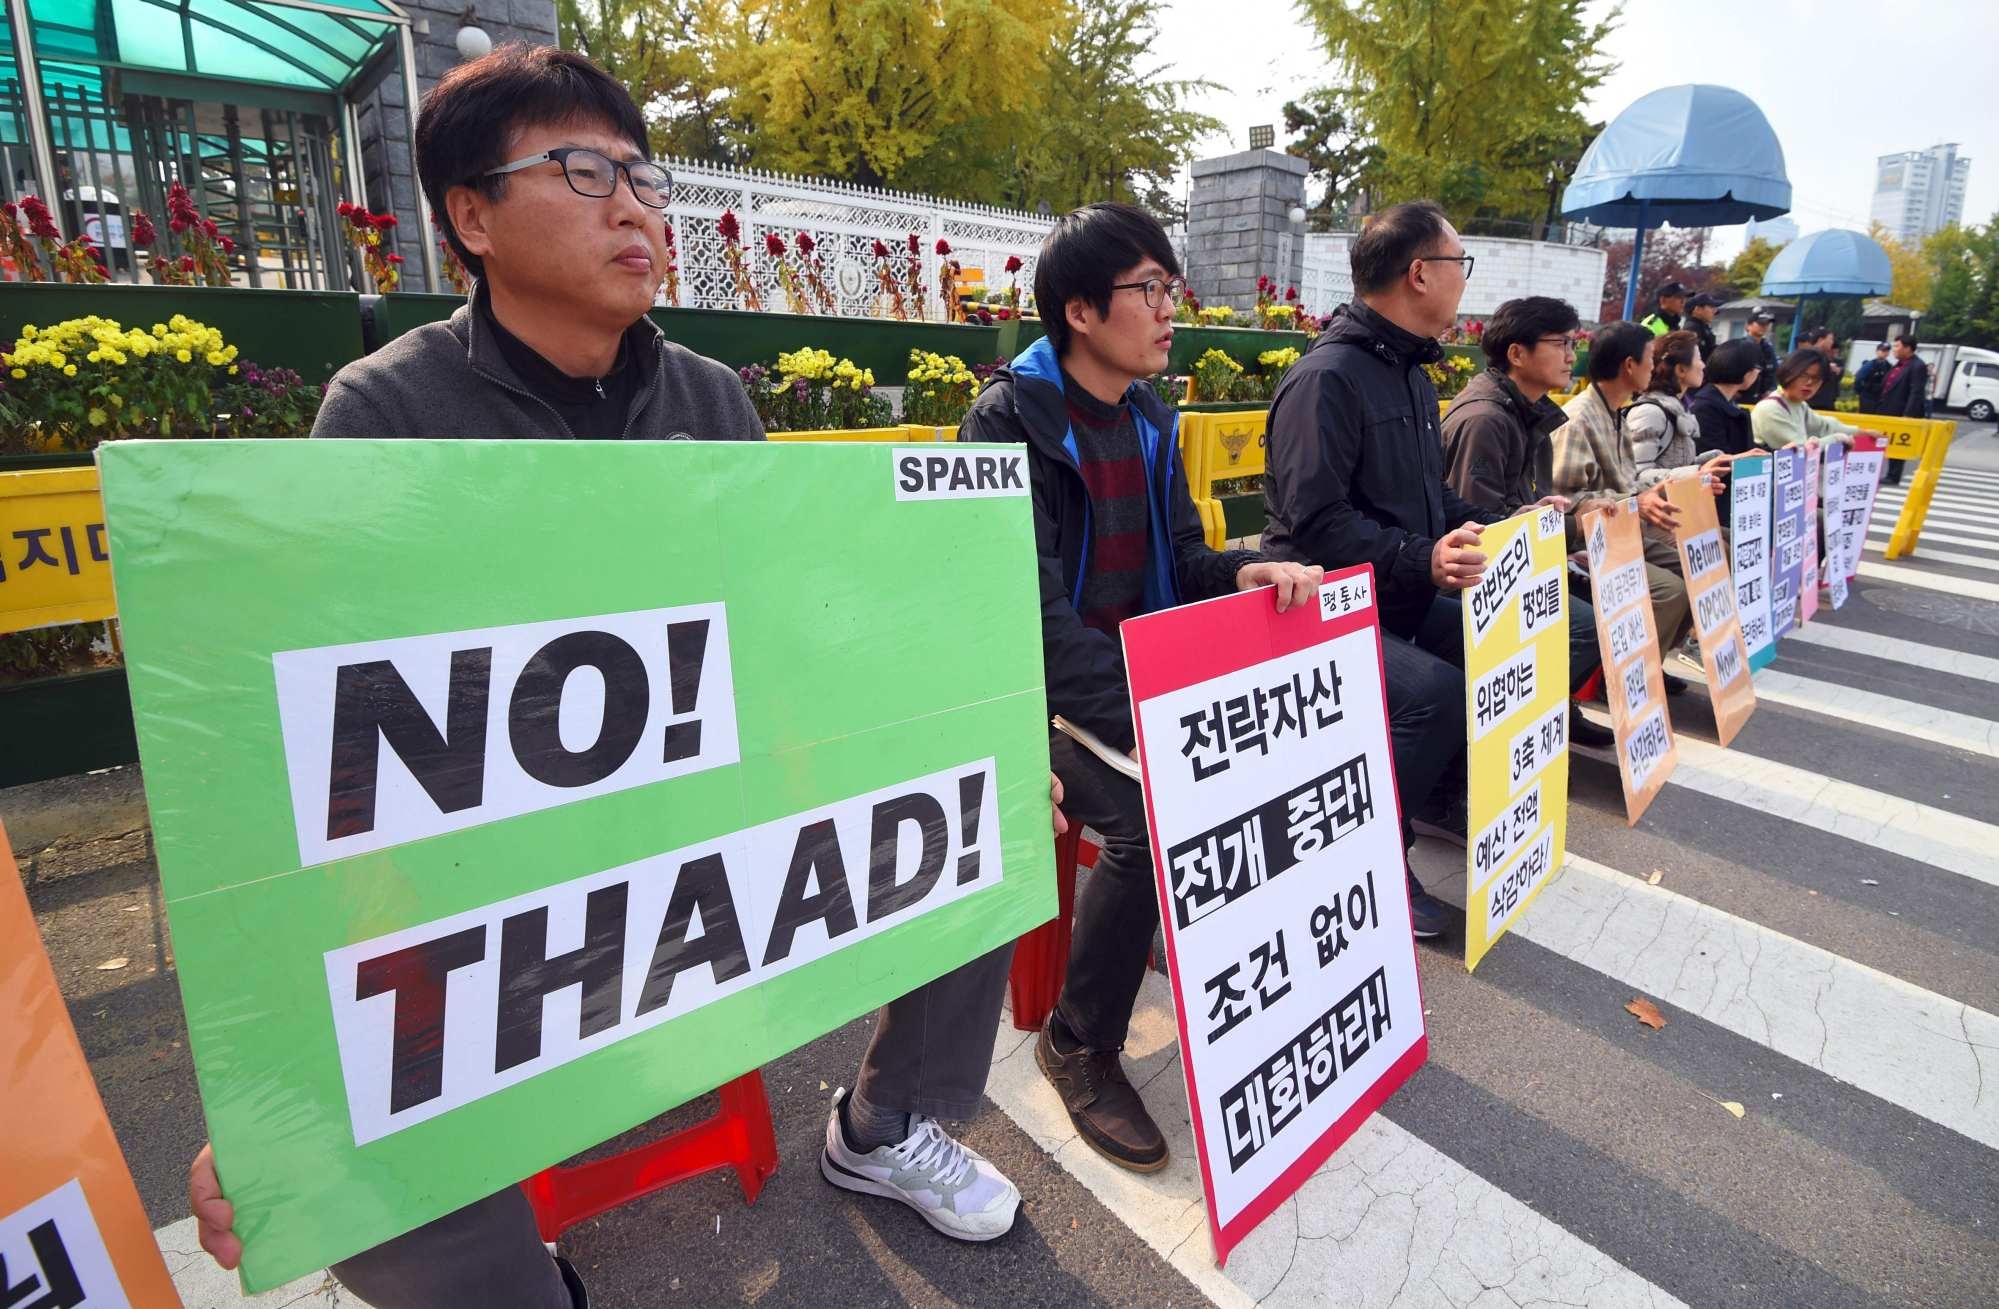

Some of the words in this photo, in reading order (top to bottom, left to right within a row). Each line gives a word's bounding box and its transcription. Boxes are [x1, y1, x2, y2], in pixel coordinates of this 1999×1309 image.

[900, 456, 1024, 493] SPARK
[1472, 532, 1530, 633] 한반도의
[1686, 541, 1722, 576] Return
[1323, 586, 1367, 611] 평통사
[1523, 577, 1560, 629] 평화를
[1698, 589, 1732, 631] OPCON
[1612, 622, 1628, 657] 도입
[1716, 639, 1739, 683] Now!
[1179, 660, 1344, 782] 전략자산
[1477, 662, 1533, 726] 위협하는
[1626, 662, 1648, 710] 전액
[326, 618, 711, 841] NO!
[1513, 735, 1534, 781] 3축
[1541, 711, 1564, 756] 체계
[1172, 806, 1268, 924] 전개
[1287, 758, 1372, 863] 중단!
[1476, 820, 1507, 872] 예산
[1513, 789, 1538, 843] 전액
[1491, 836, 1550, 918] 삭감하라!
[356, 770, 986, 1115] THAAD!
[1204, 928, 1292, 1046] 조건
[1309, 869, 1379, 969] 없이
[1224, 973, 1387, 1158] 대화하라!
